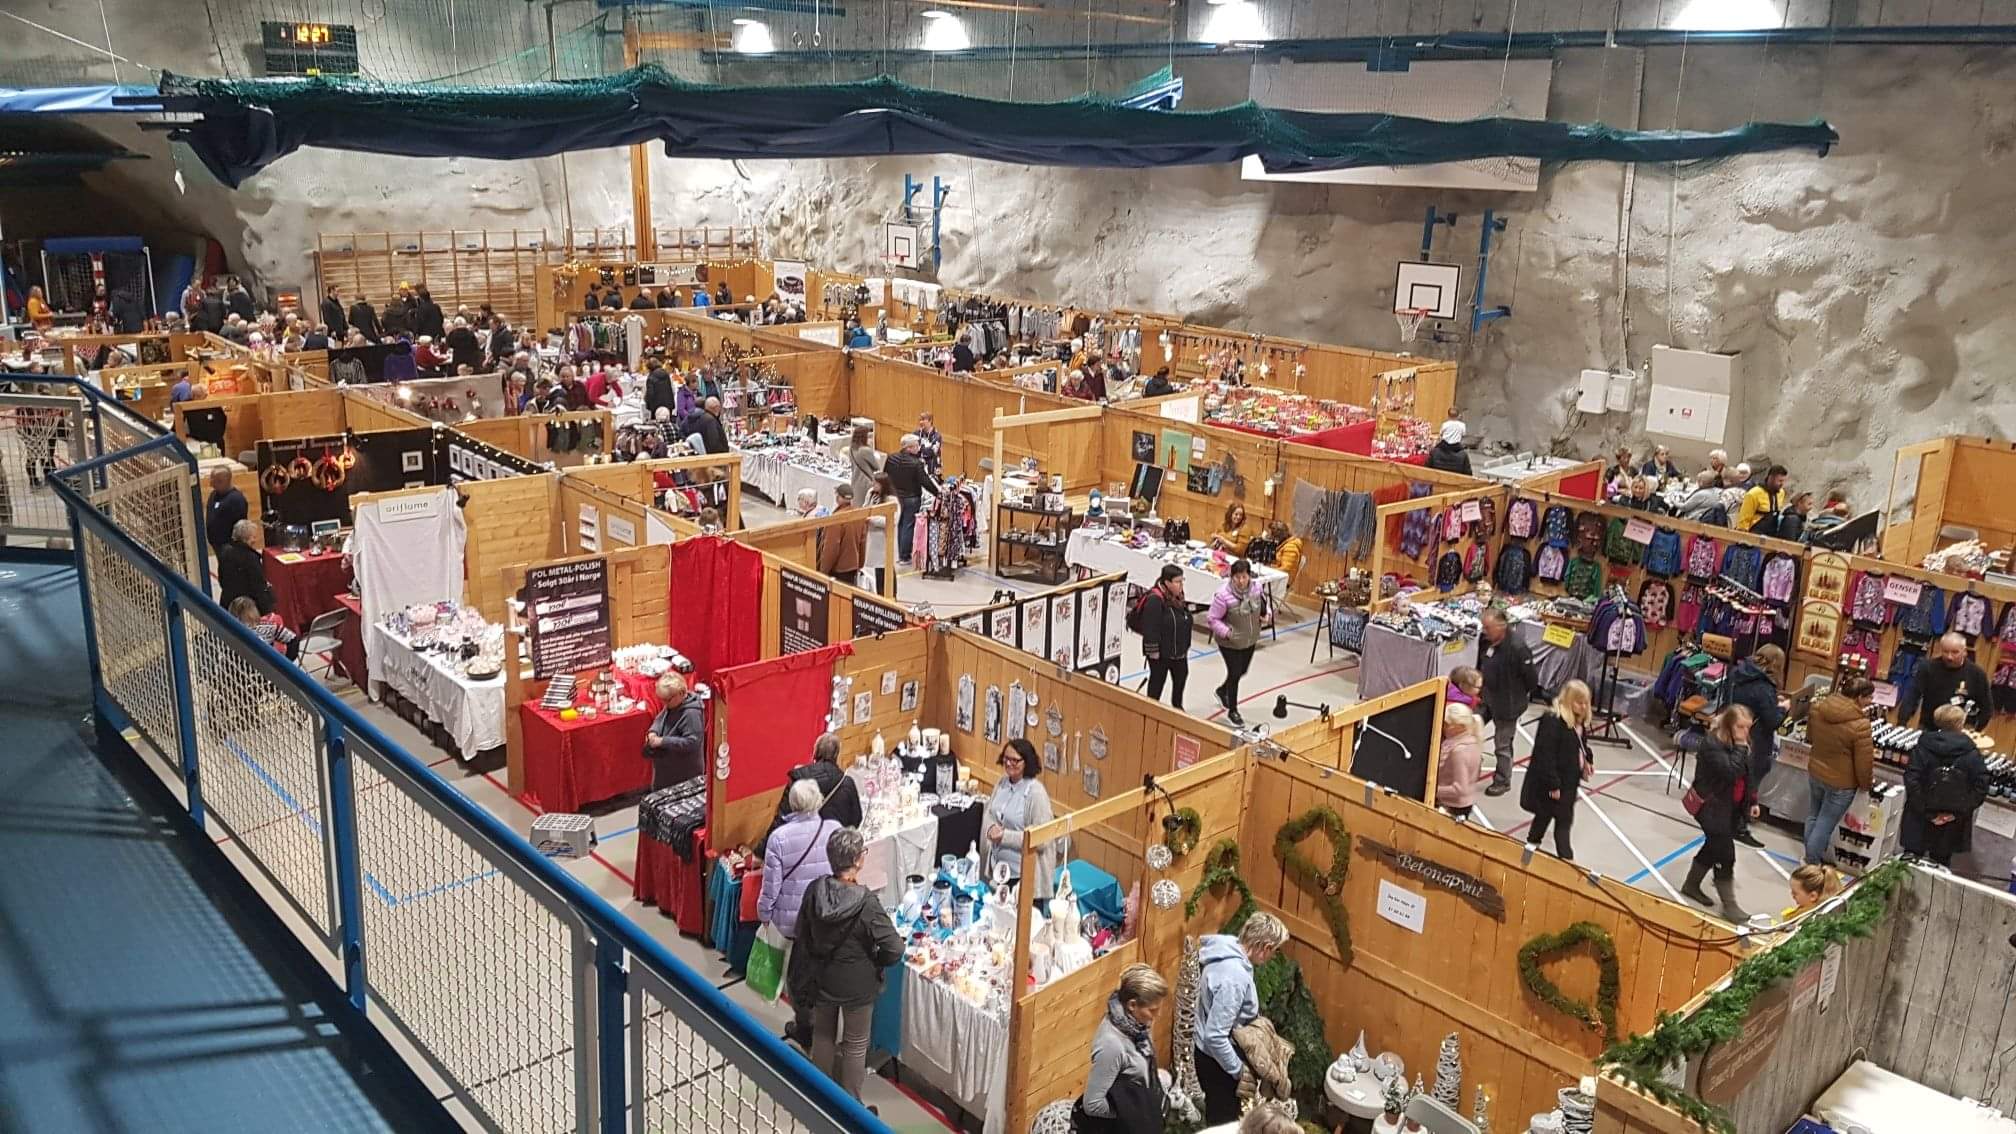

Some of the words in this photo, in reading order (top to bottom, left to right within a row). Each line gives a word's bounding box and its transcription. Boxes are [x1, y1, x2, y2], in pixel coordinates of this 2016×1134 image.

[385, 502, 429, 512] oriflame
[531, 570, 548, 579] POL
[548, 561, 601, 577] METAL-POLISH
[579, 572, 601, 582] Norge
